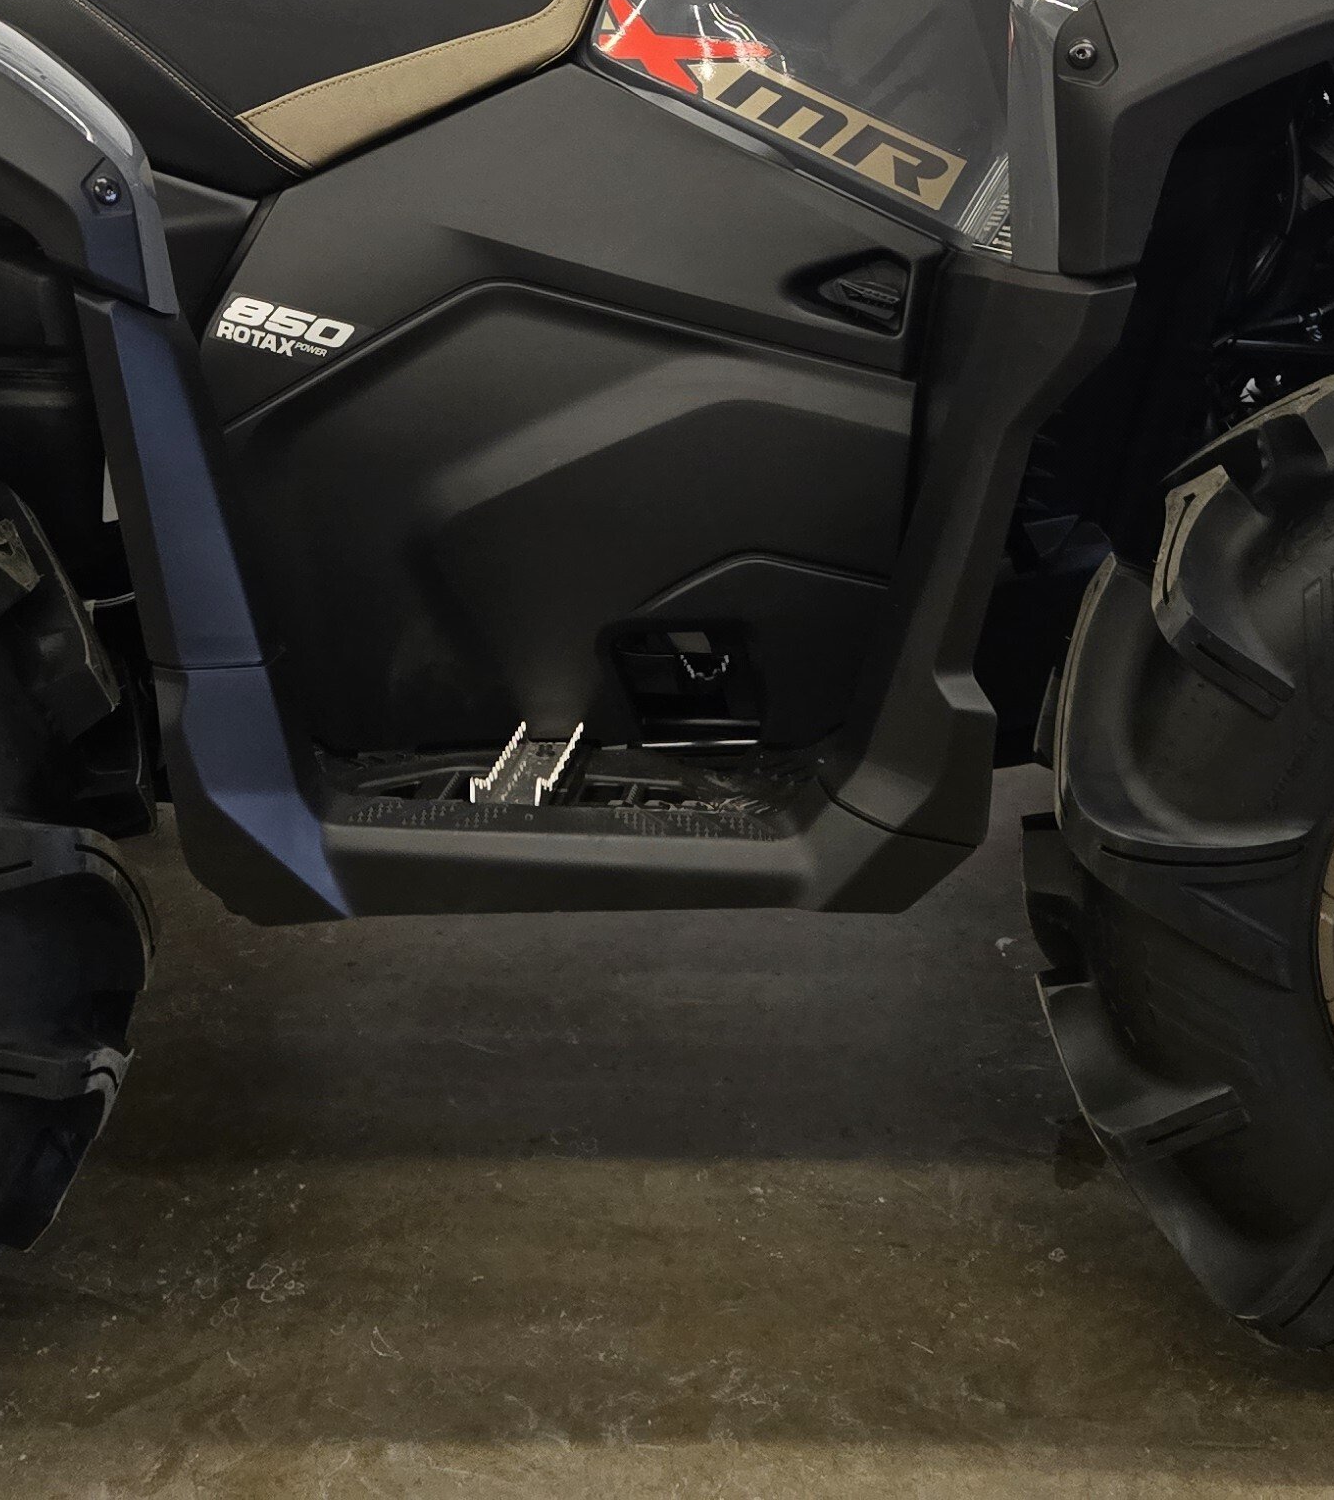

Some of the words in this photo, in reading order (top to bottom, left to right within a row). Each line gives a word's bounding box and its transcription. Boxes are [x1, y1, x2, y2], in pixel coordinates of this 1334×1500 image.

[216, 320, 294, 357] ROTAX
[294, 342, 328, 358] POWER
[222, 296, 355, 348] 850
